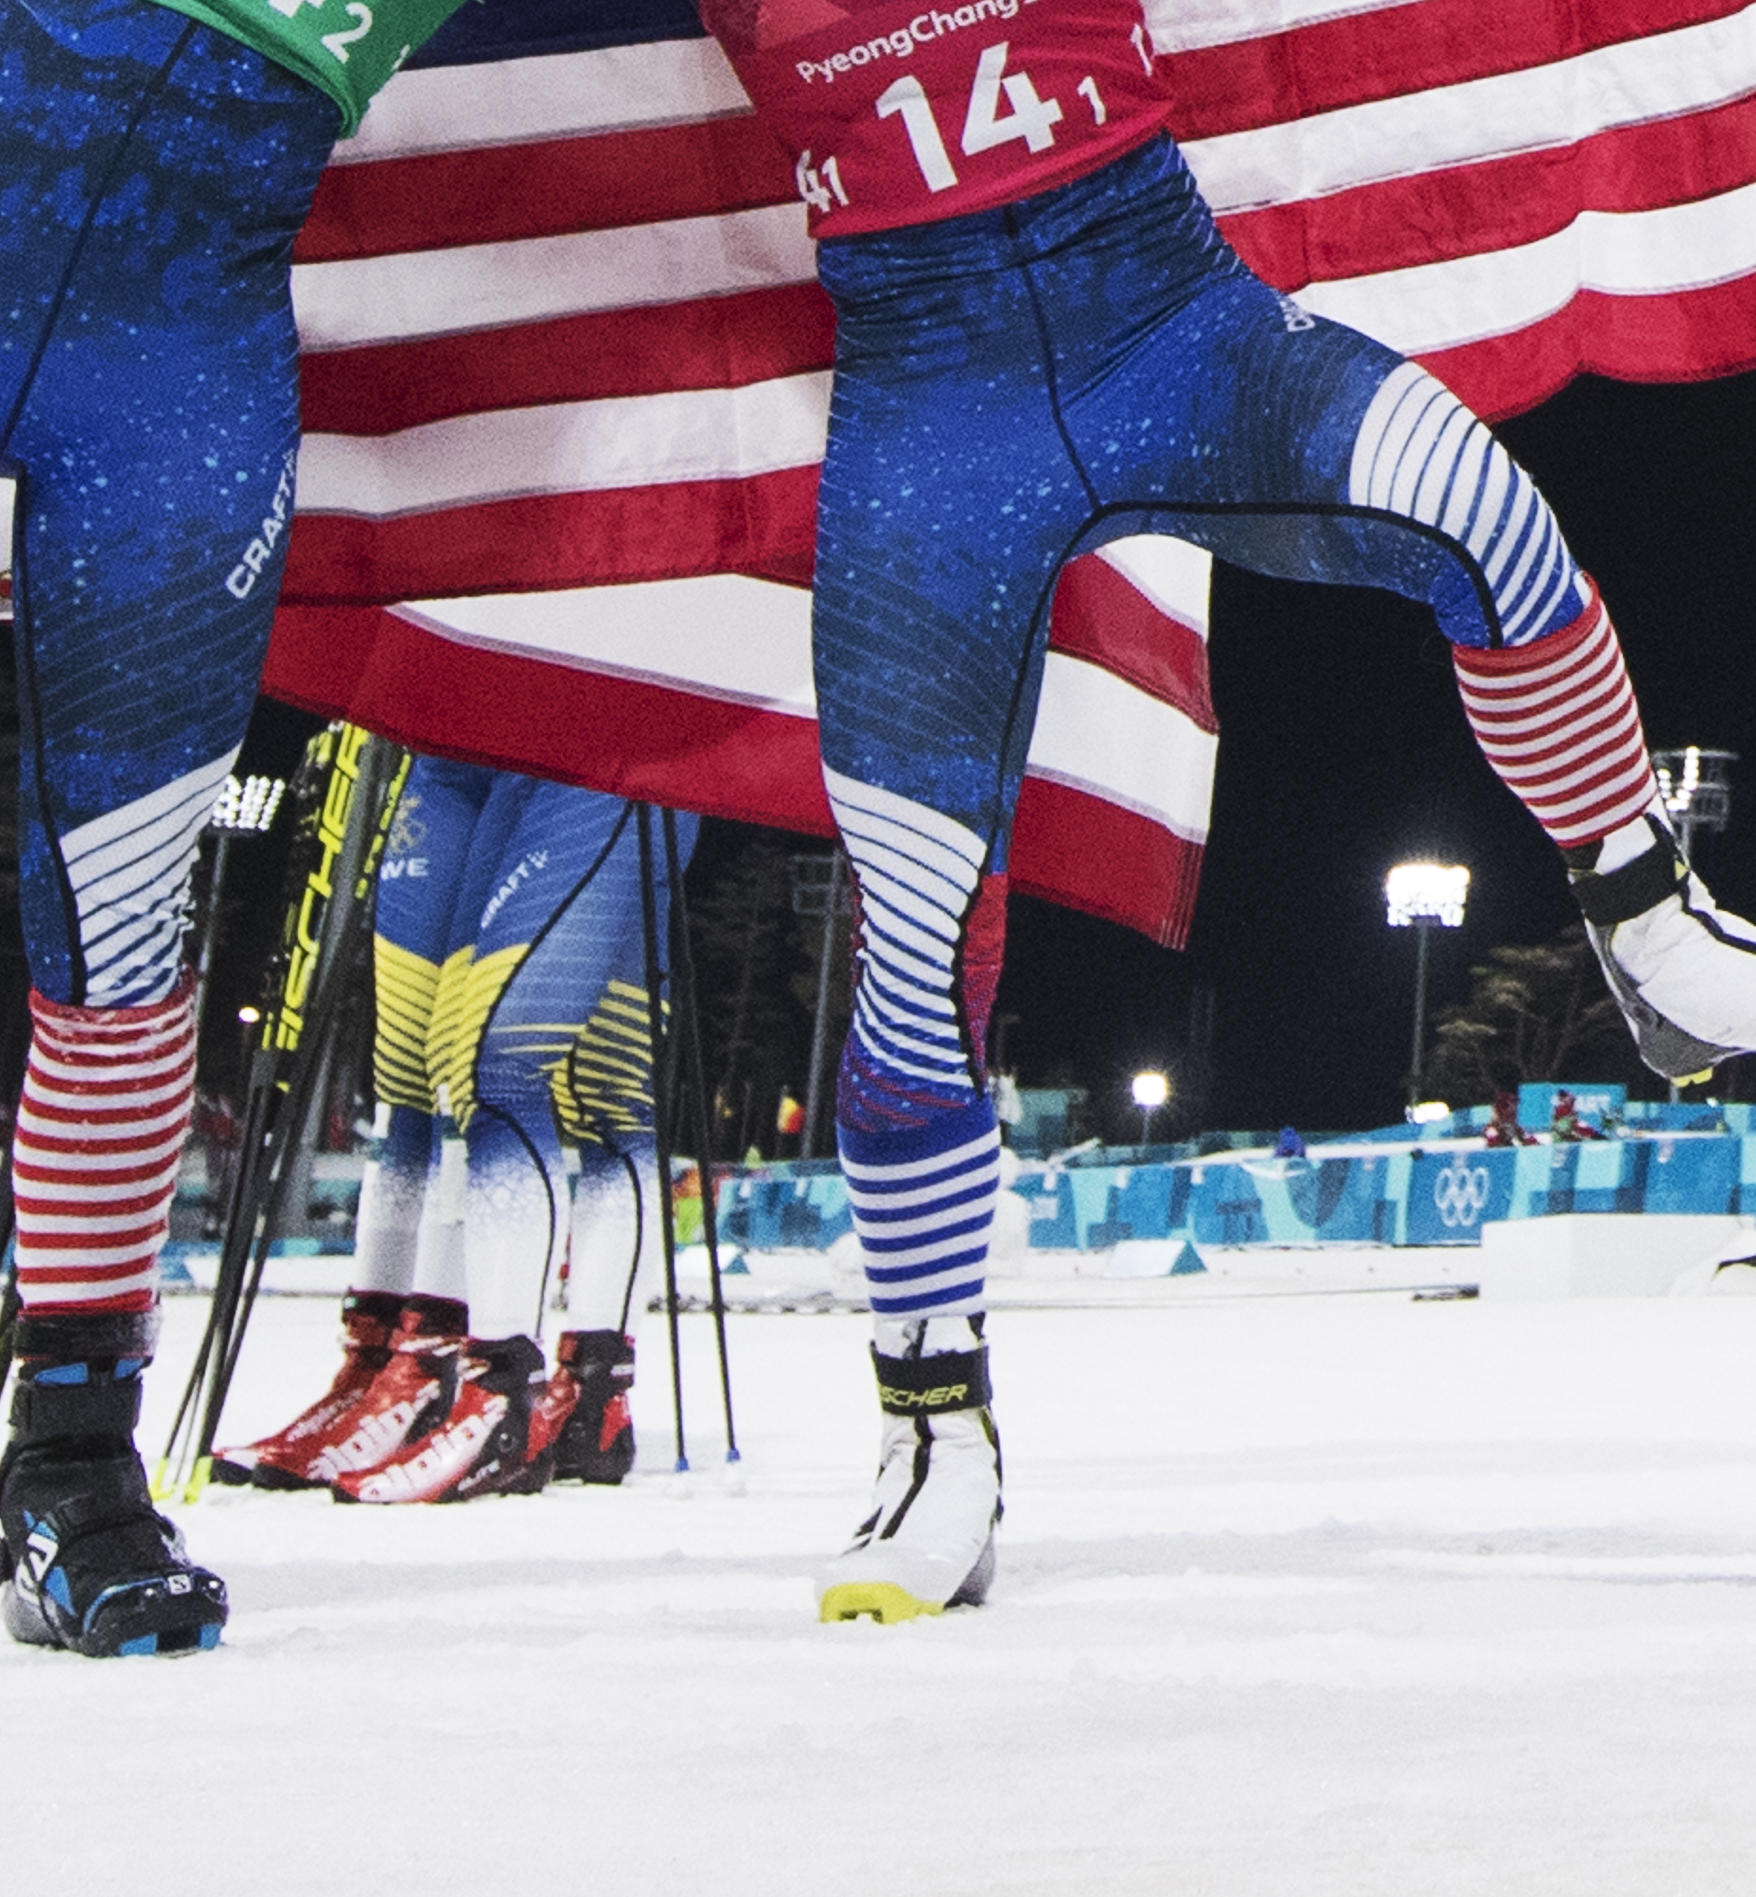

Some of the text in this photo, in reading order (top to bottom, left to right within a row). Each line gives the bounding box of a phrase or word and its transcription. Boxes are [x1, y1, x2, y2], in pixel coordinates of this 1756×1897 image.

[321, 2, 373, 64] 2
[875, 41, 1064, 193] 14
[1076, 75, 1107, 126] 1
[226, 469, 291, 599] CRAFT
[275, 721, 369, 1052] FISCHER
[381, 856, 430, 881] WE
[880, 1383, 968, 1407] SCHER
